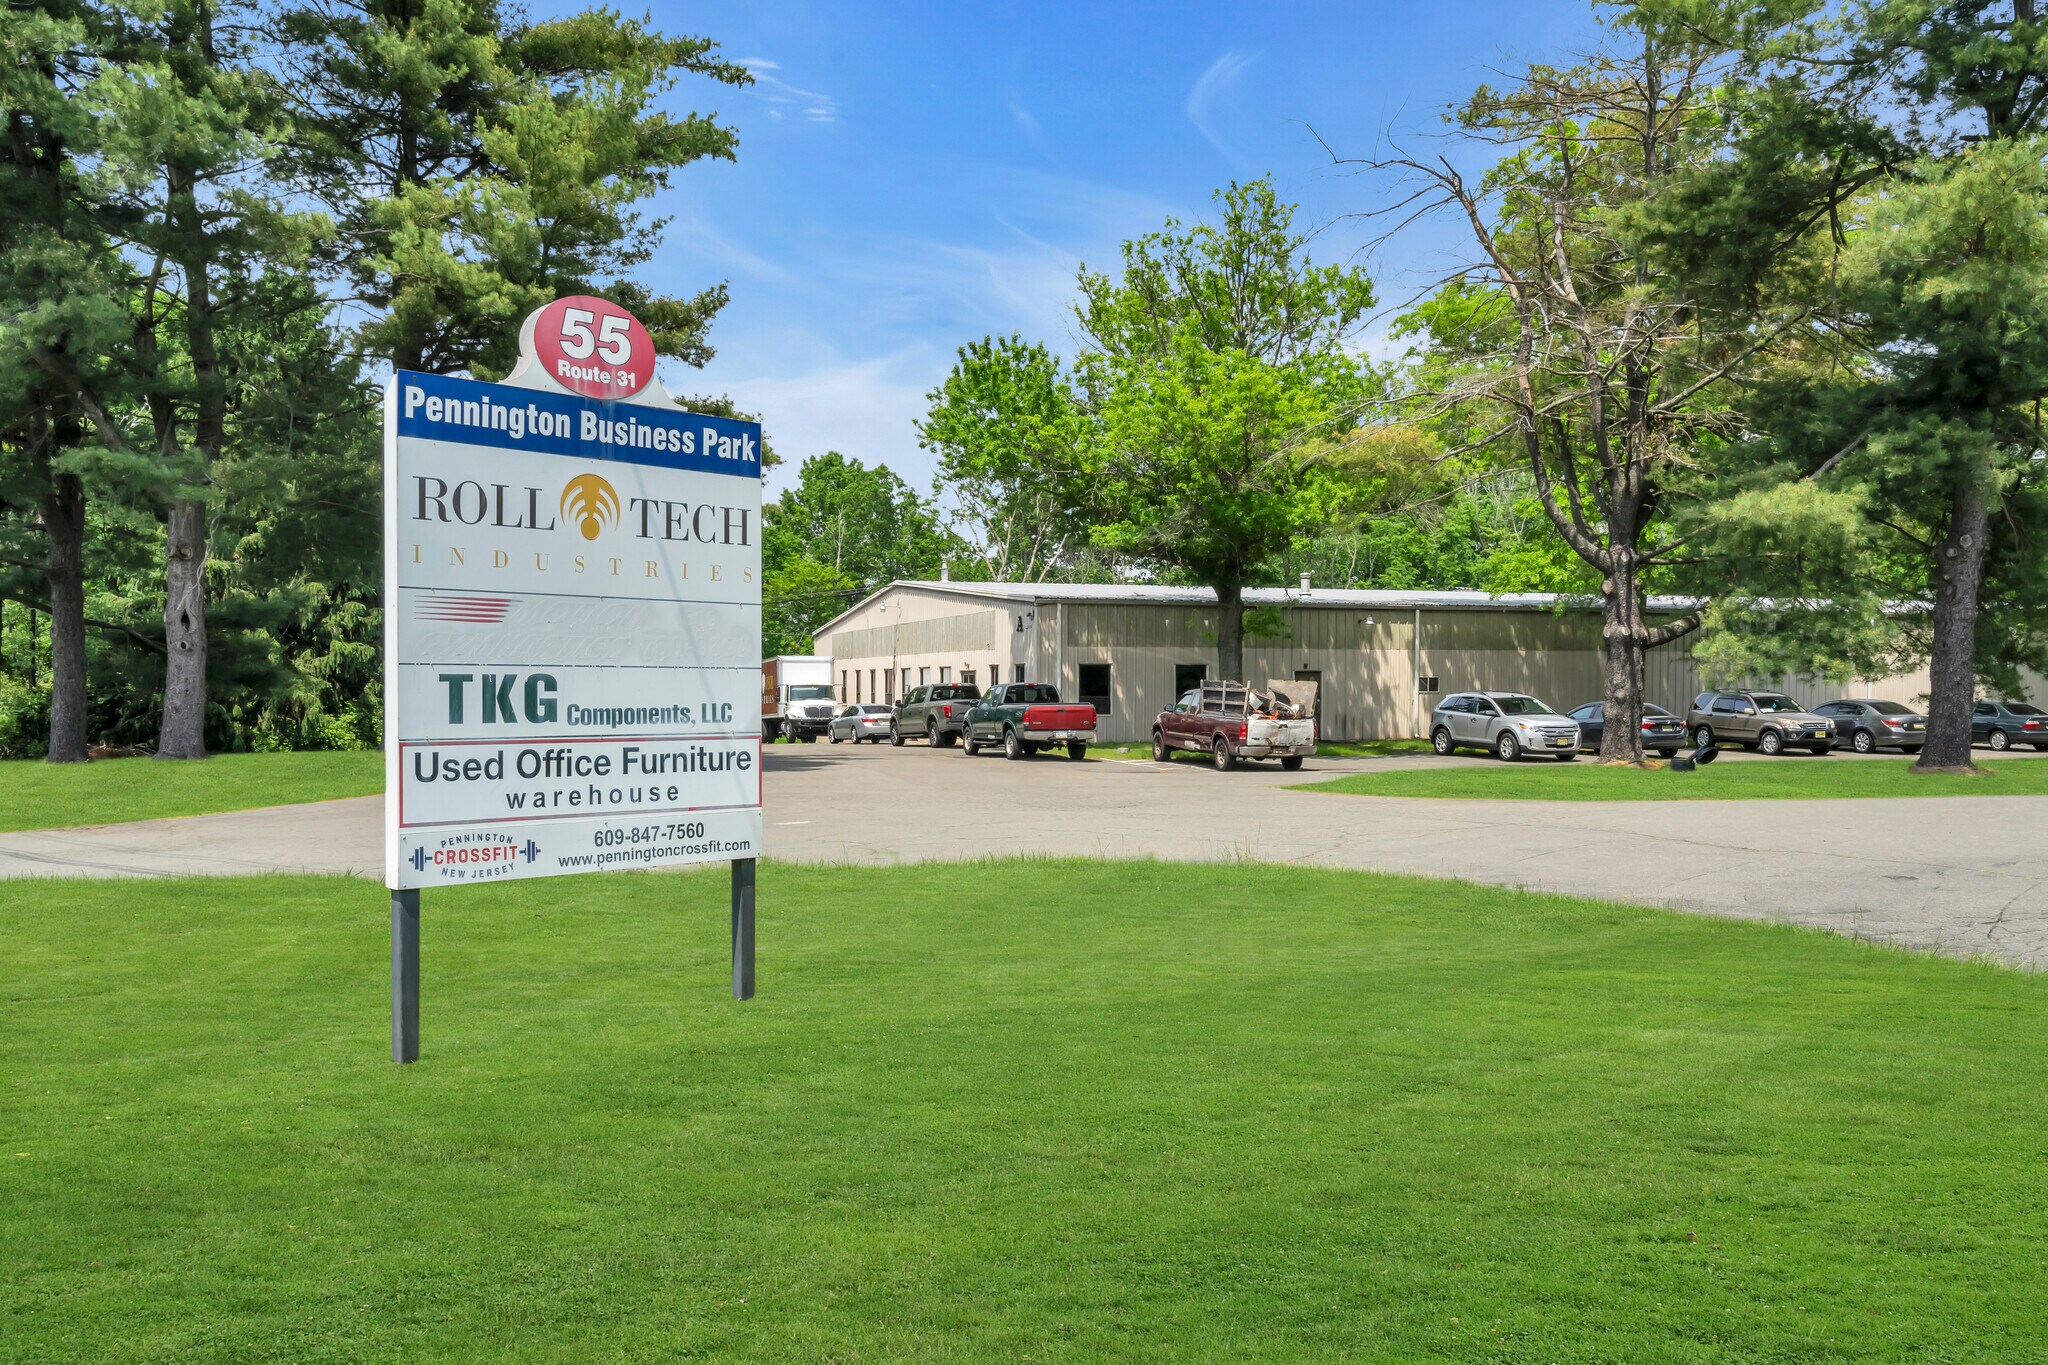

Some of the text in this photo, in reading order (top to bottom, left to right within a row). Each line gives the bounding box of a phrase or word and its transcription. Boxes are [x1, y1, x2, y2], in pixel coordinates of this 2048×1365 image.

[559, 307, 633, 366] 55
[557, 358, 637, 389] Route 31
[404, 384, 756, 463] Pennington Business Park
[412, 475, 753, 547] ROLL TECH
[412, 543, 753, 584] INDUSTRIES
[438, 673, 733, 729] TKG Components, LLC
[413, 745, 753, 783] Used Office Furniture
[505, 783, 681, 810] warehouse
[440, 833, 514, 849] PENNINGTON
[593, 822, 705, 848] 609-847-7560
[433, 845, 518, 866] CROSSFIT
[558, 840, 752, 868] www.penningtoncrossfit.com
[441, 862, 515, 879] NEW JERSEY
